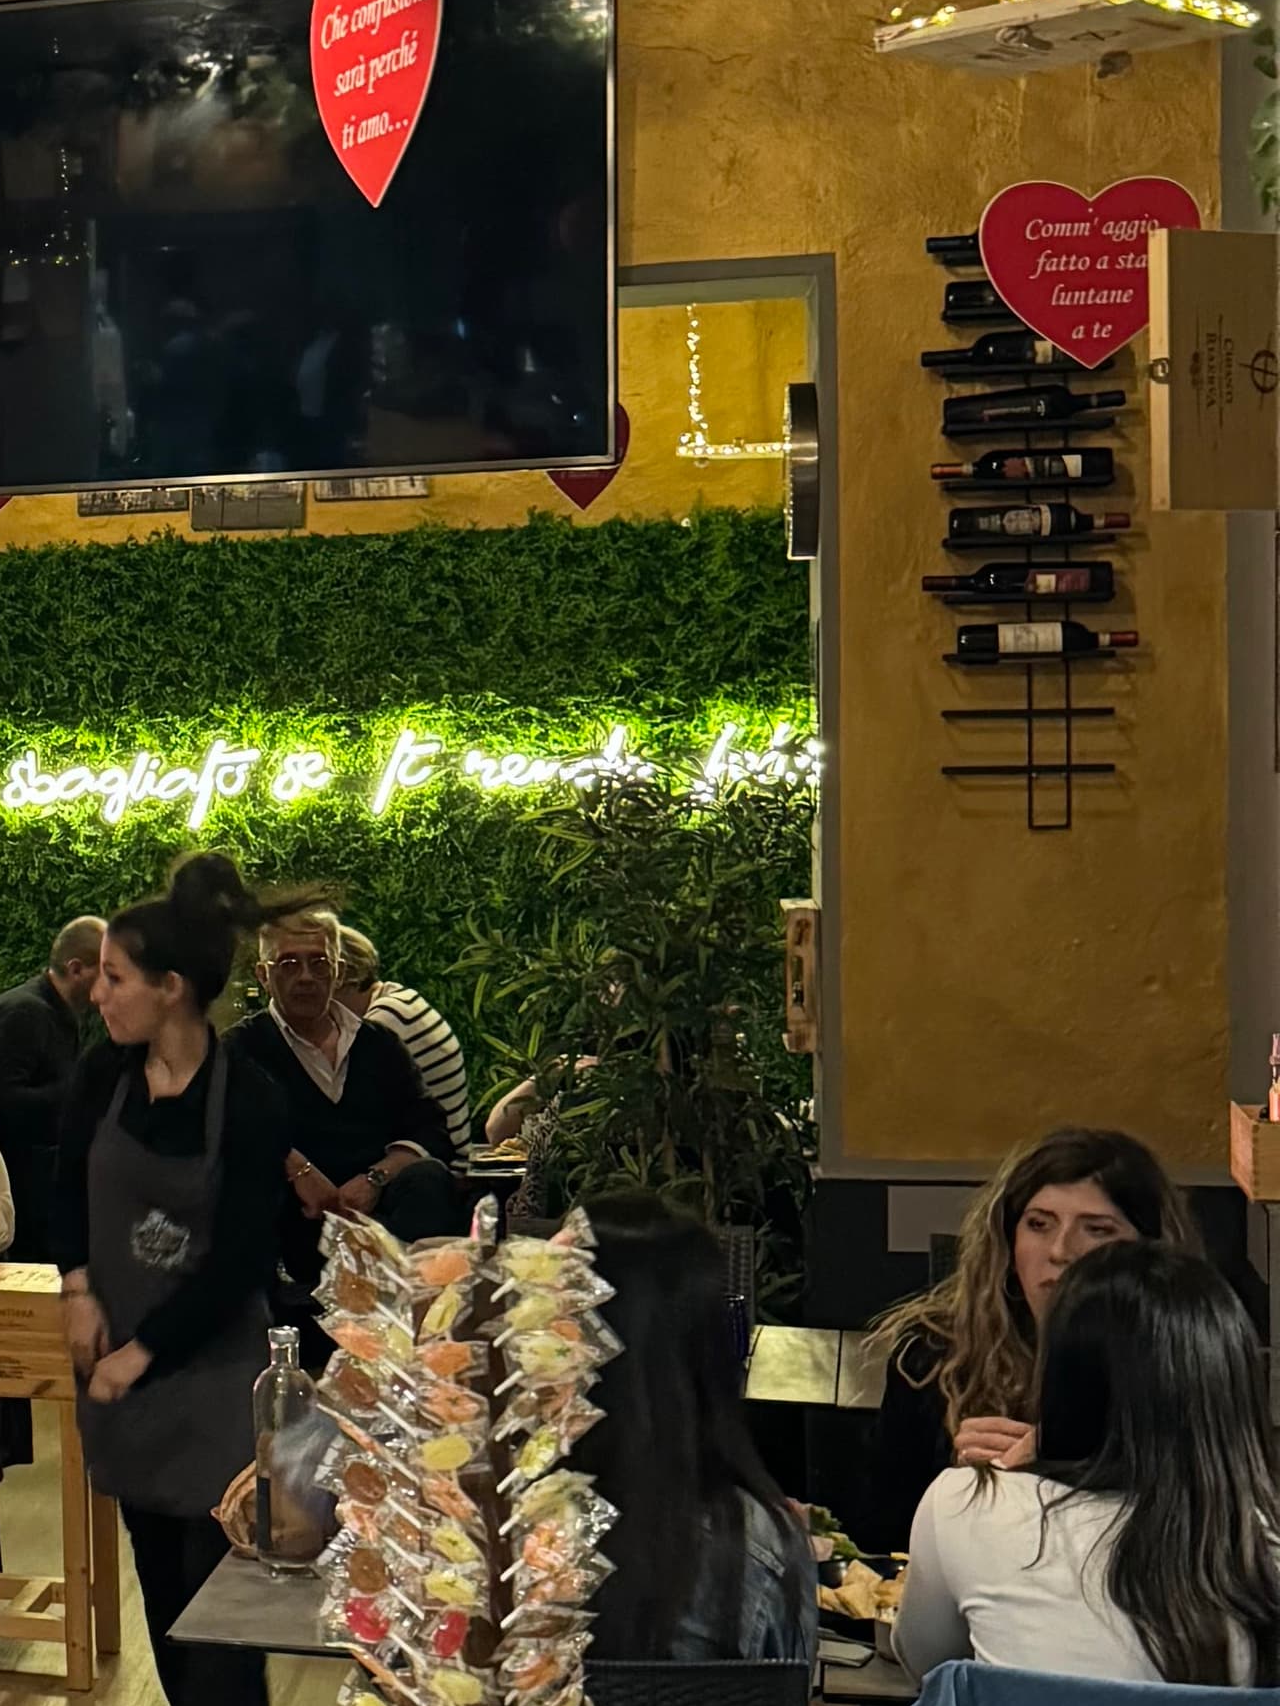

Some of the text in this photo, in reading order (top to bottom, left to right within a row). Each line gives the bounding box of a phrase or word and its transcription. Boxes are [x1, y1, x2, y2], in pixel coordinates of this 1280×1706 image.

[321, 5, 347, 50] Che
[334, 29, 418, 97] sarà perché
[342, 111, 409, 150] ti amo...
[1025, 213, 1159, 242] Comm' aggio
[1029, 249, 1090, 280] fatto
[1096, 256, 1109, 270] a
[1051, 284, 1134, 306] luntane
[1072, 322, 1113, 340] a te
[2, 738, 261, 831] sbagliato
[272, 748, 333, 802] se
